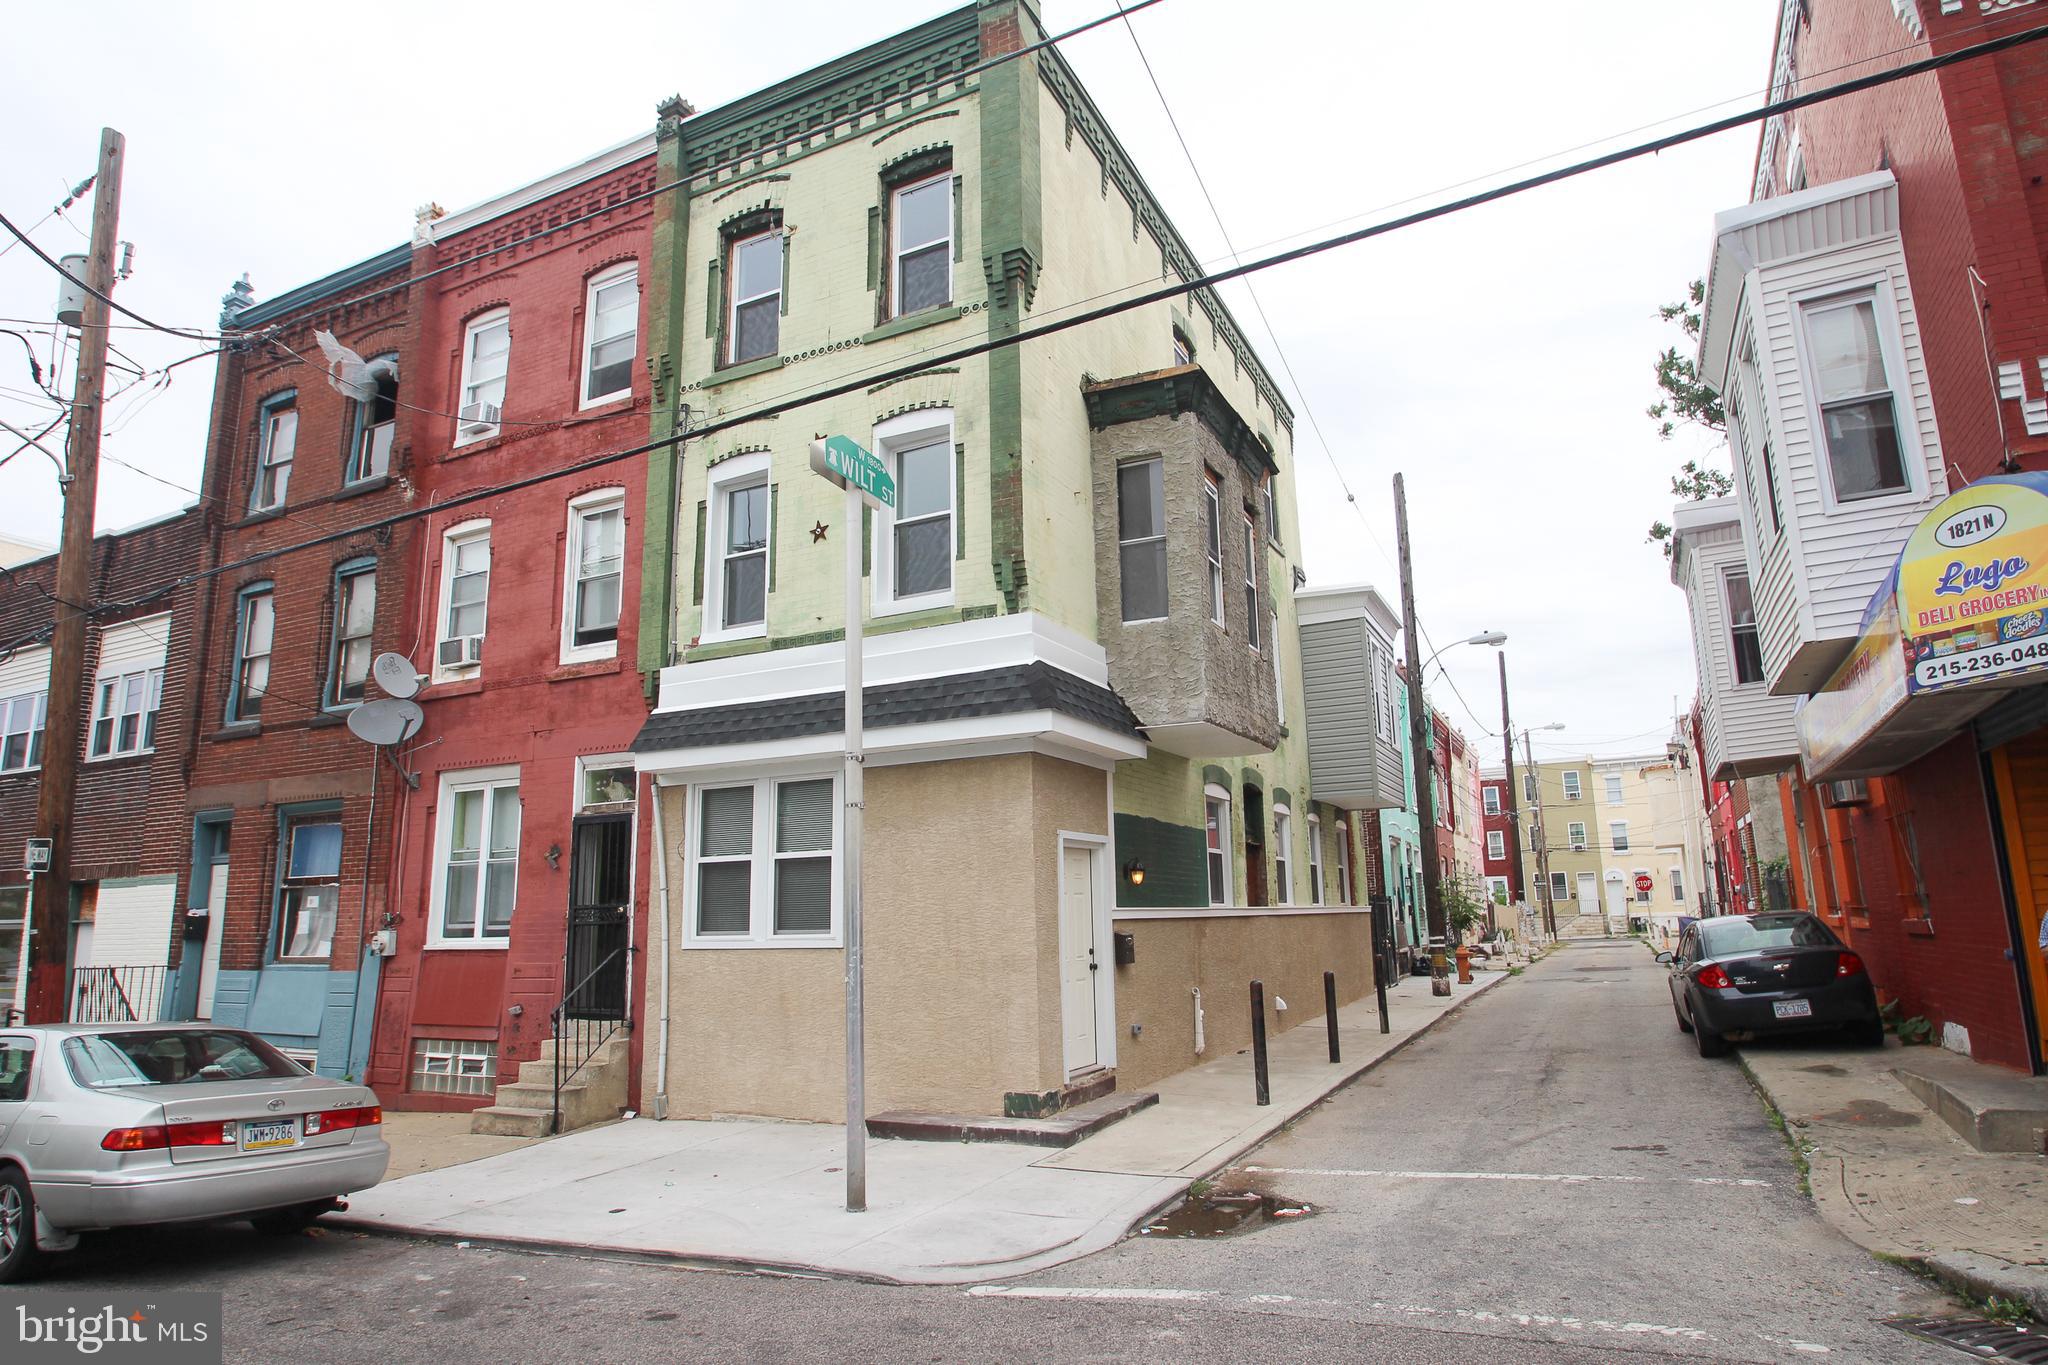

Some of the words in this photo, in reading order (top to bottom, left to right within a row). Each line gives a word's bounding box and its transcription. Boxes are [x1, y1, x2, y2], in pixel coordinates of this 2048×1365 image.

[858, 448, 866, 460] W
[841, 451, 876, 492] WILT
[882, 486, 893, 504] ST
[1947, 517, 1981, 539] 1821
[1983, 513, 1994, 529] N
[1918, 605, 1954, 627] DELI
[1959, 584, 2039, 617] GROCERY
[1926, 642, 2048, 680] 215-236-048
[1636, 880, 1651, 888] STOP
